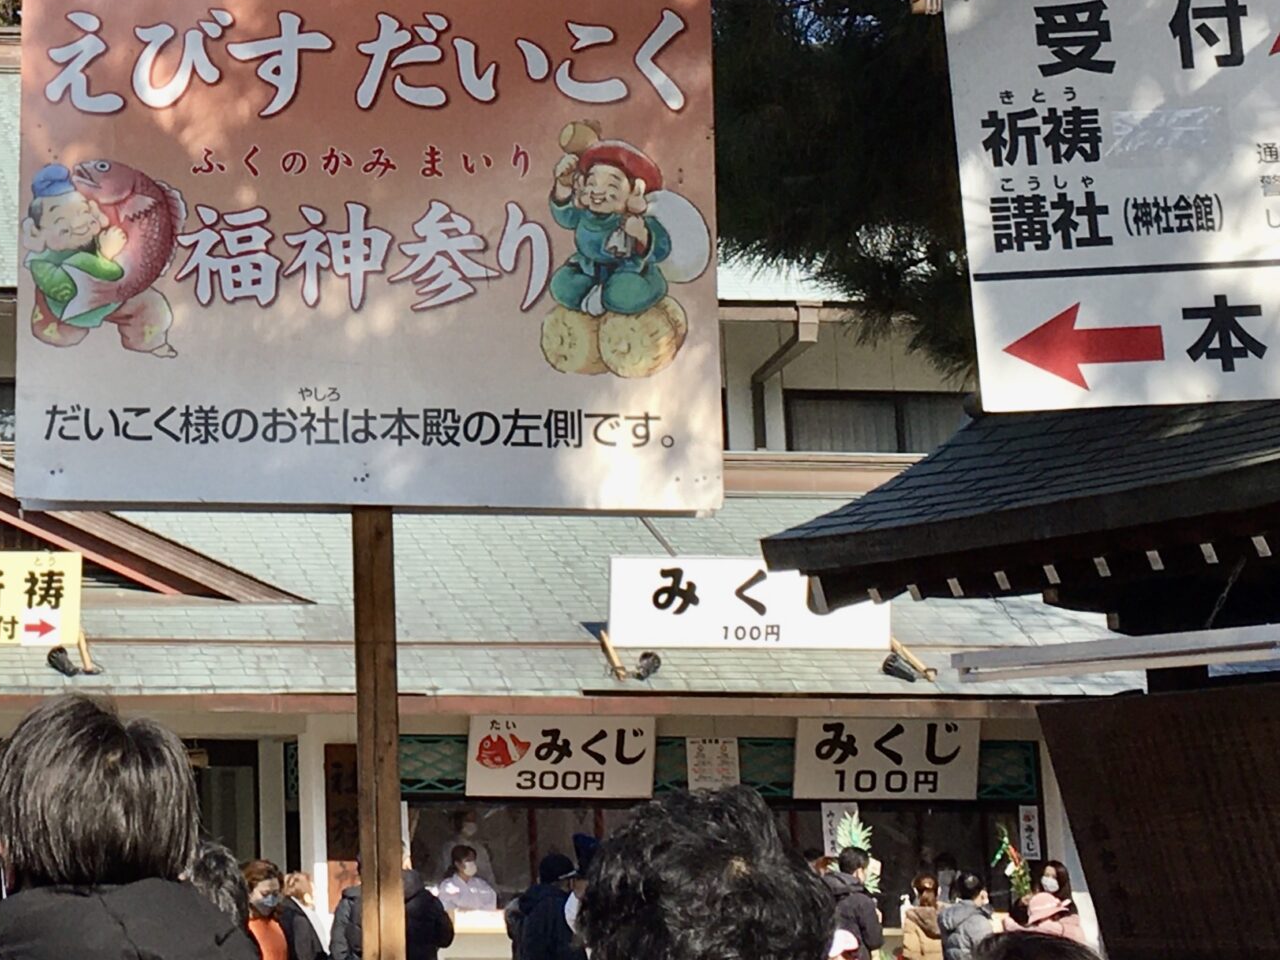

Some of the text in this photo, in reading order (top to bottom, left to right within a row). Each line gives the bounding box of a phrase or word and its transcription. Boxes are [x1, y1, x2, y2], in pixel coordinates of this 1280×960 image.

[45, 7, 688, 118] えびす だいこく
[999, 86, 1077, 104] きとう
[981, 106, 1103, 167] 祈祷
[1000, 175, 1095, 192] こうしゃ
[990, 191, 1114, 253] 講社
[176, 200, 552, 313] 福神参り
[1182, 294, 1268, 372] 本
[298, 386, 341, 401] やしろ
[45, 404, 676, 449] だいこく様のお社は本殿の左側です。
[722, 625, 781, 642] 100円
[490, 720, 516, 730] たい
[815, 722, 962, 766] みくじ
[535, 728, 647, 766] みくじ
[516, 771, 605, 791] 300円
[835, 770, 939, 793] 100円
